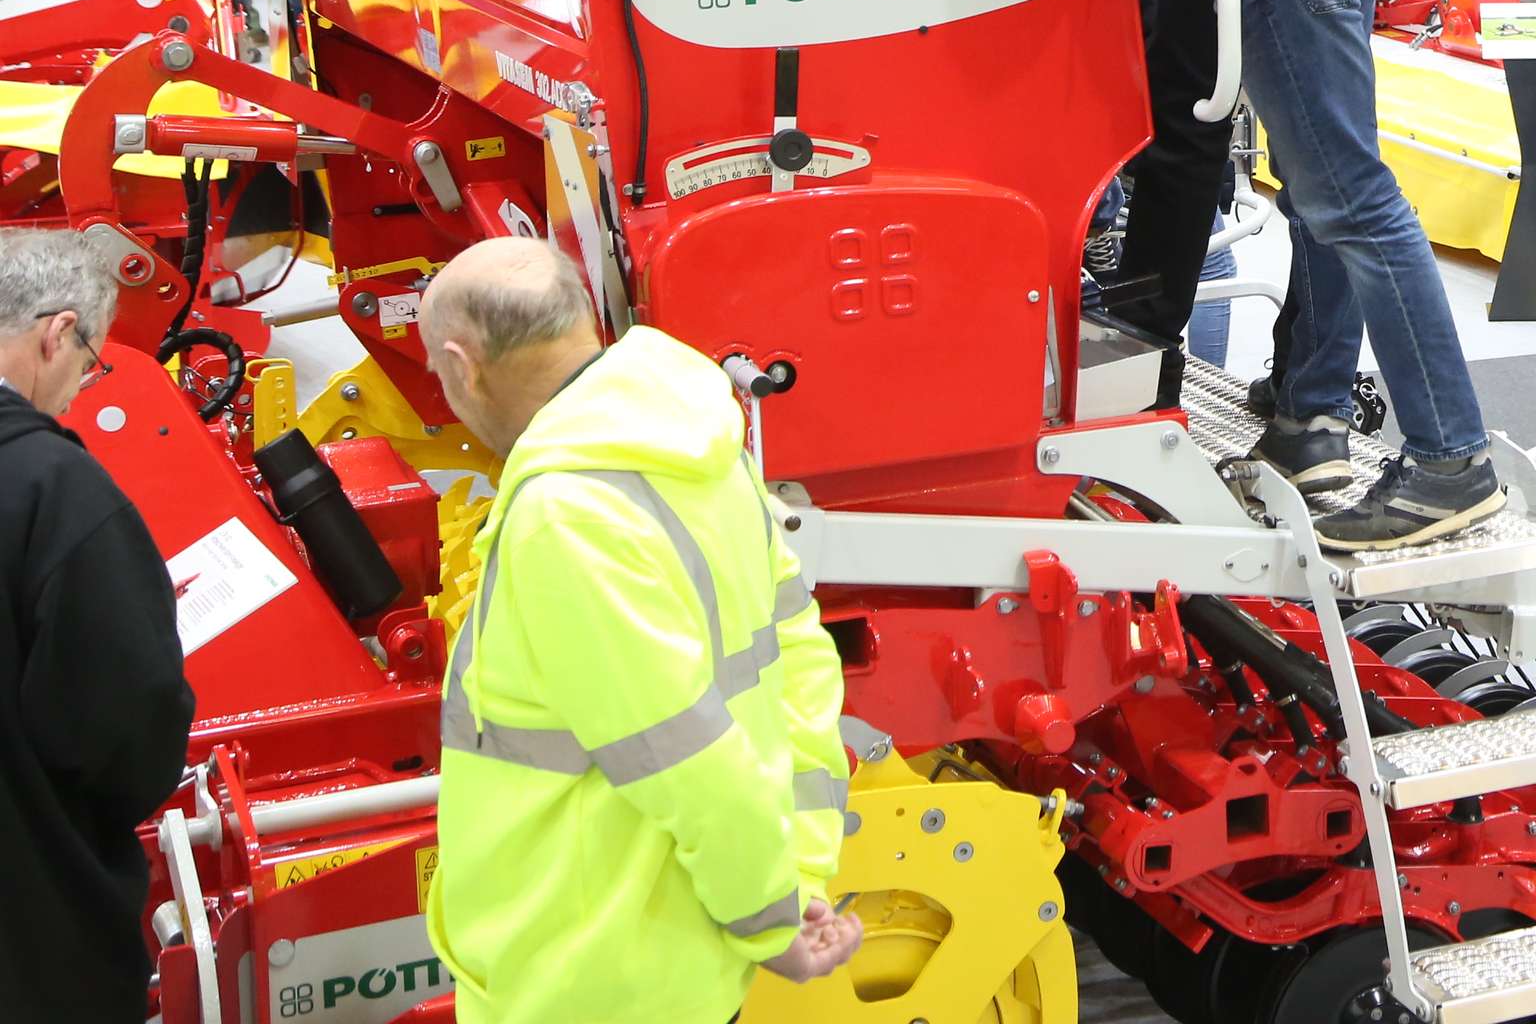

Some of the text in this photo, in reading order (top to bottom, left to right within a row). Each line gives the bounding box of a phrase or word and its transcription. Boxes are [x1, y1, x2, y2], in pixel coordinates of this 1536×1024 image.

[495, 50, 536, 95] VITASEM
[688, 183, 698, 193] 90
[703, 178, 713, 187] 80
[717, 174, 727, 182] 70
[732, 171, 742, 179] 60
[747, 168, 757, 176] 50
[761, 167, 771, 175] 40
[807, 167, 815, 175] 10
[322, 956, 456, 1009] PÖTT
